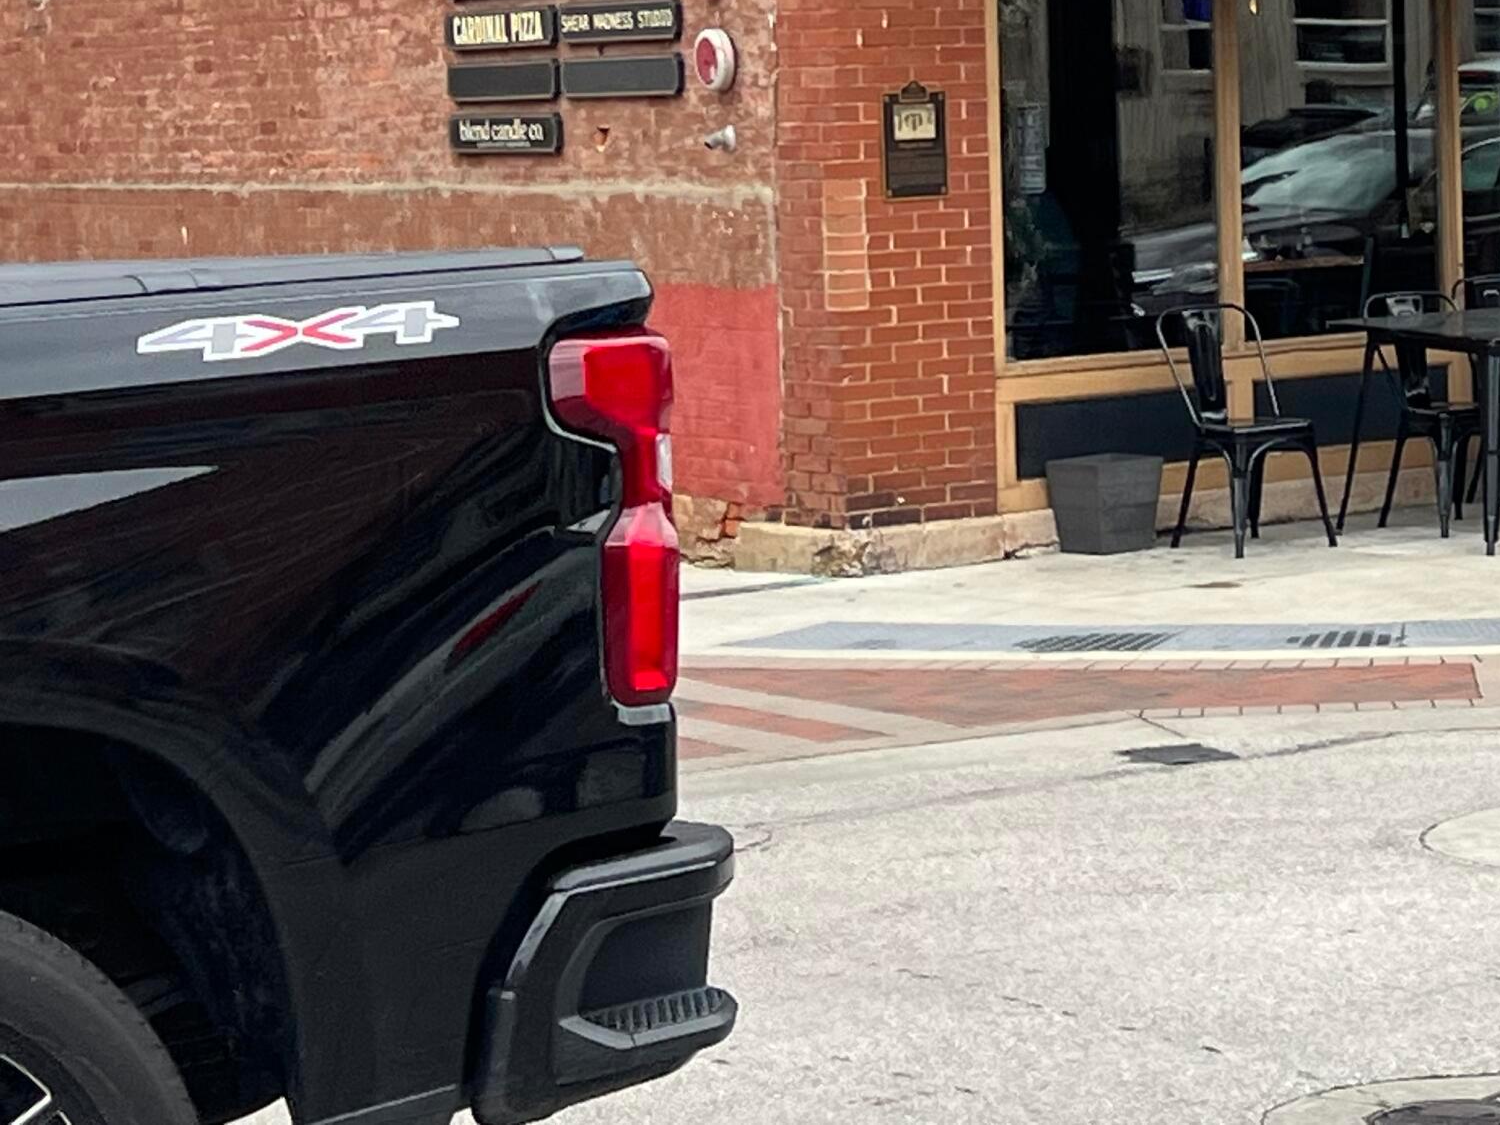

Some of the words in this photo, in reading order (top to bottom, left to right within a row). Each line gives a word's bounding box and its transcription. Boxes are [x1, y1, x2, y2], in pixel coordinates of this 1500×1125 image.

[453, 14, 509, 45] CARDINAL
[510, 11, 544, 42] PIZZA
[560, 14, 590, 33] SHEAR
[458, 119, 490, 141] blend
[490, 118, 528, 141] candle
